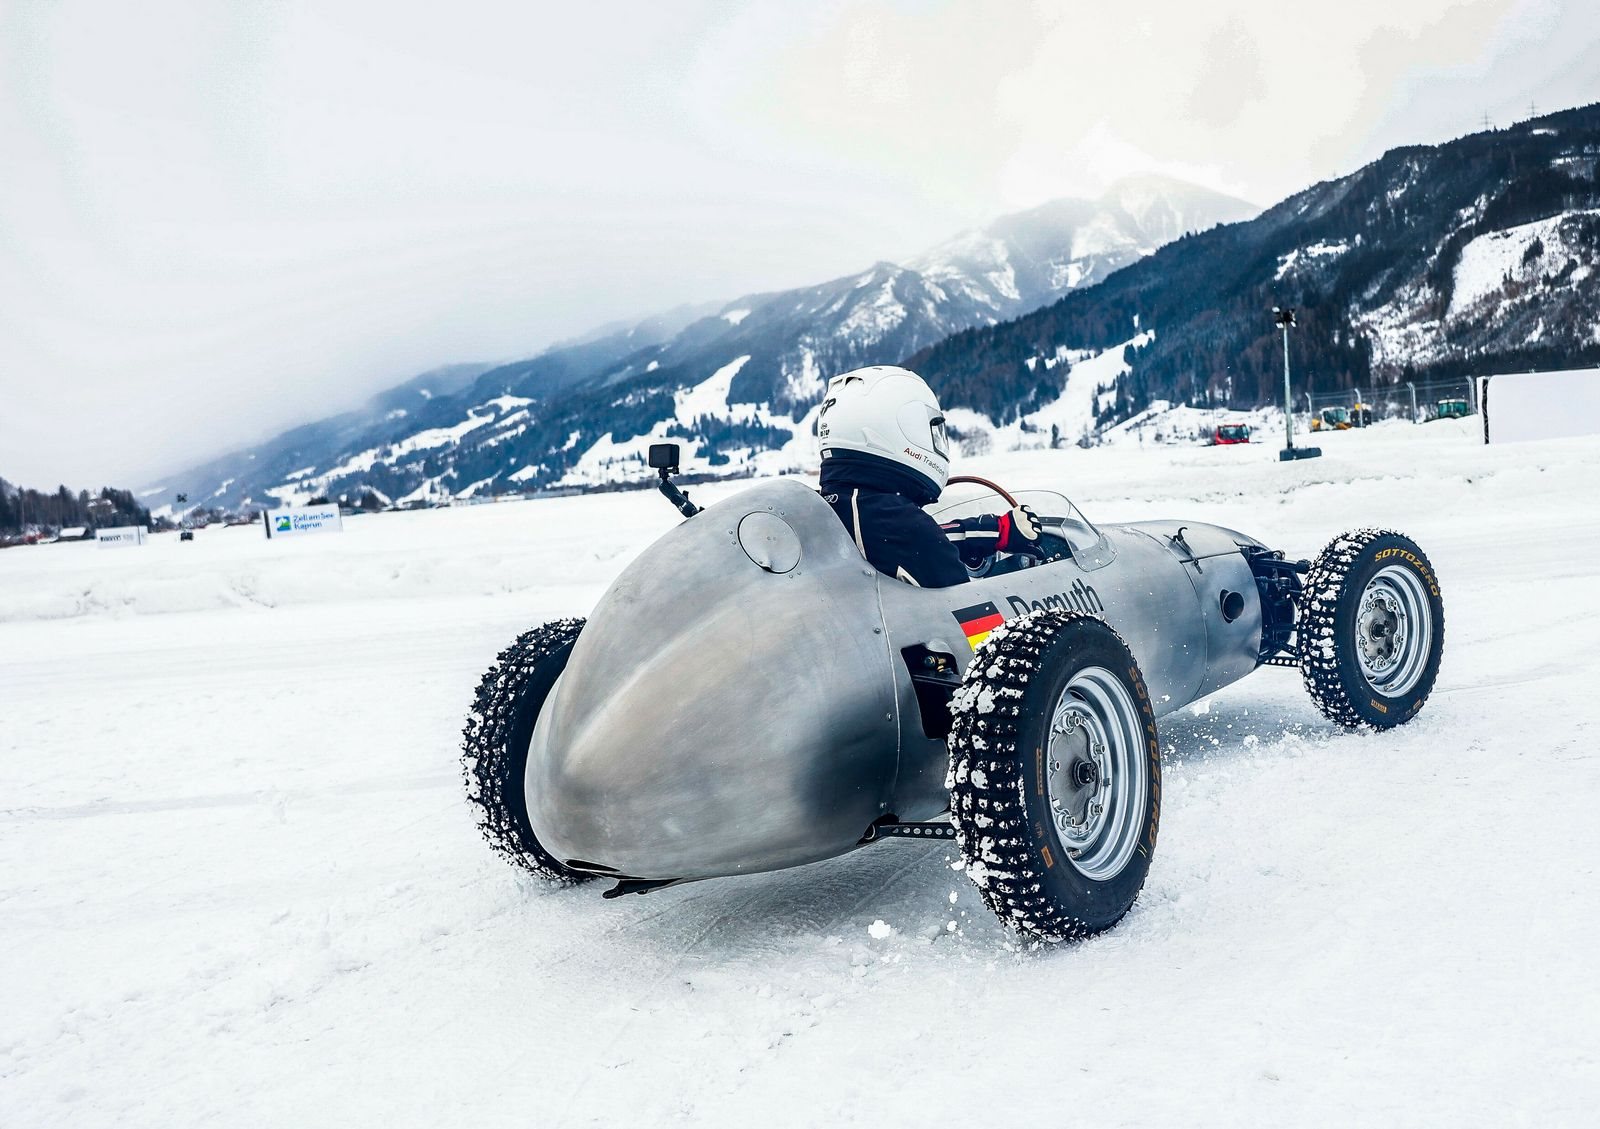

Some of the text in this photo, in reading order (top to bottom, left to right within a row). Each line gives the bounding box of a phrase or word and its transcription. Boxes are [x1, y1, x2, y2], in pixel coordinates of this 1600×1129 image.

[903, 447, 945, 477] Audi Tradition
[294, 521, 323, 531] Kaprun
[1375, 548, 1439, 597] SOTTOZERO
[1128, 666, 1160, 848] SOTTOZERO
